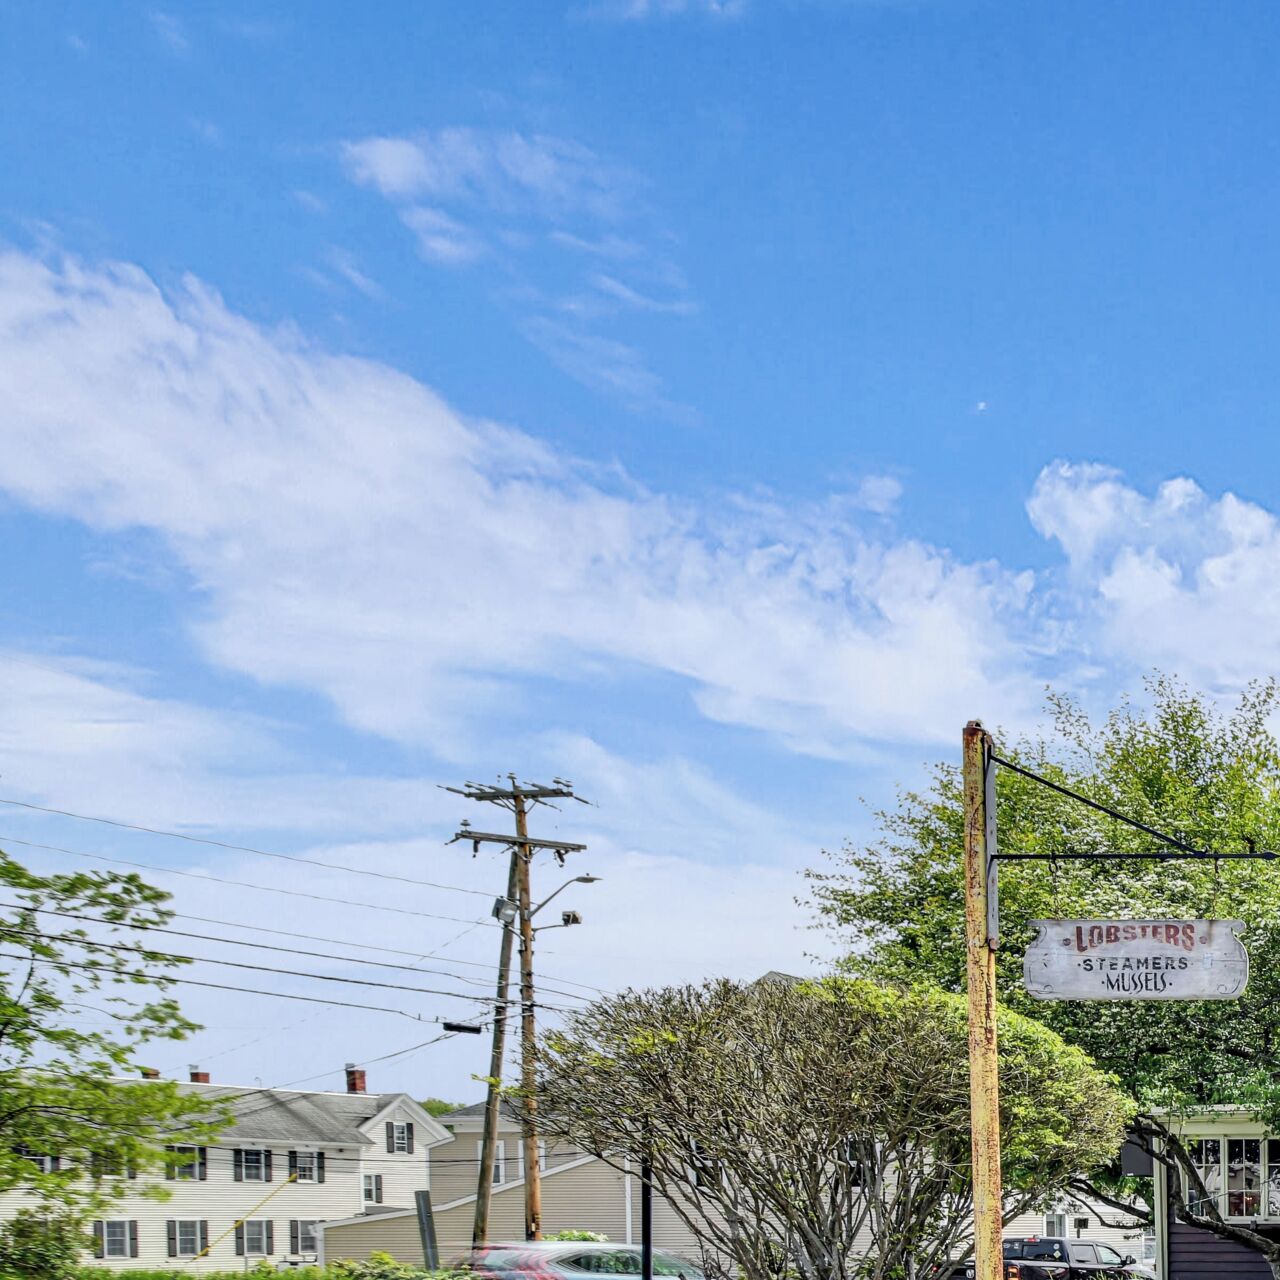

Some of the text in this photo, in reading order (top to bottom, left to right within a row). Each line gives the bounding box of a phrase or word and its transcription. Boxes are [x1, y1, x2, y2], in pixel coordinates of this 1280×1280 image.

[1075, 924, 1195, 952] LOBSTERS
[1083, 957, 1188, 972] STEAMERS
[1106, 972, 1167, 994] MUSSELS
